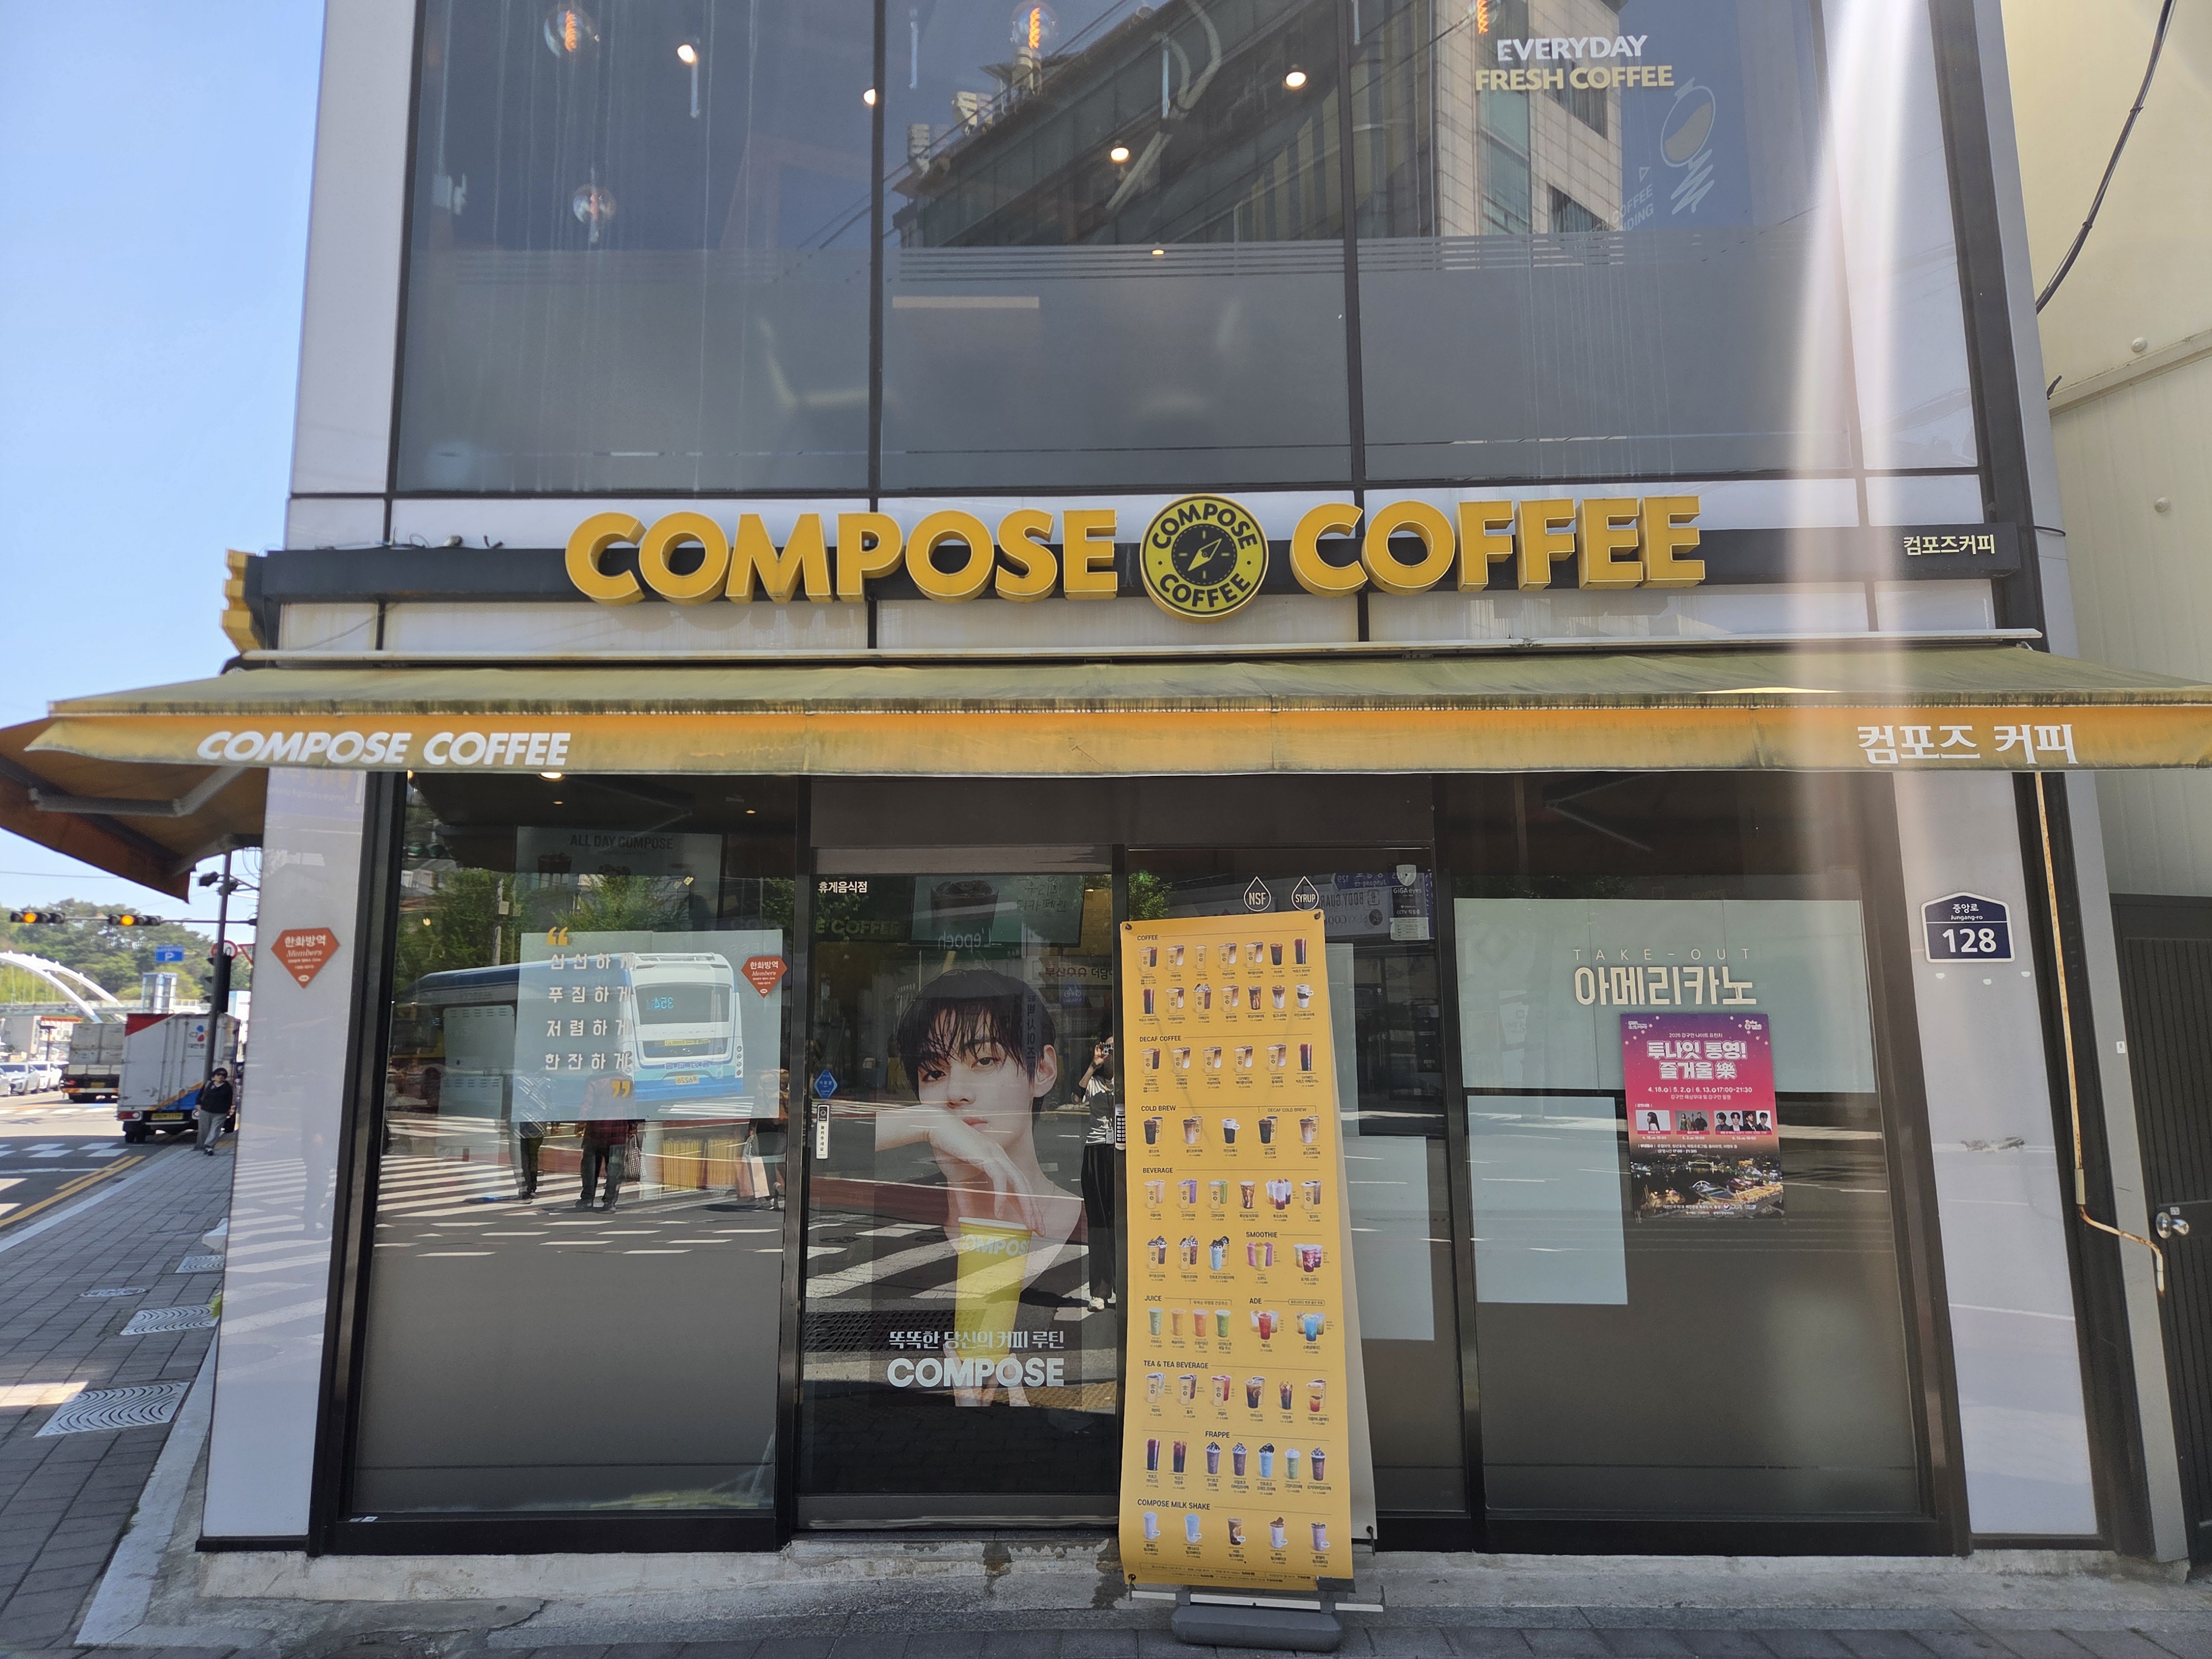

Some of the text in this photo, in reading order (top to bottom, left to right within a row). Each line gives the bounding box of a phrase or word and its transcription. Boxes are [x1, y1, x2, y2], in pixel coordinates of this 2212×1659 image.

[1498, 35, 1648, 61] EVERYDAY
[1475, 65, 1674, 91] FRESH COFFEE
[1152, 503, 1258, 550] COMPOSE
[1289, 496, 1705, 598] COFFEE
[1903, 534, 1995, 556] 컴포즈커피
[565, 509, 1118, 605] COMPOSE
[1160, 573, 1251, 608] COFFEE
[197, 731, 571, 765] COMPOSE COFFEE
[1857, 724, 2079, 764] 컴포즈 커피
[570, 834, 674, 849] ALL DAY COMPOSE
[818, 880, 868, 894] 휴게음식점
[1249, 893, 1266, 905] NSF
[1295, 893, 1316, 904] SYRUP
[1953, 904, 1979, 914] 중앙로
[1942, 928, 1997, 953] 128
[165, 952, 175, 961] P
[1573, 948, 1749, 961] TAKE-OUT
[750, 961, 779, 969] 한화방역
[548, 985, 632, 1004] 푸짐하게
[1574, 967, 1756, 1005] 아메리카노
[546, 1019, 633, 1037] 저렴하게
[1647, 1040, 1747, 1060] 투나잇 통영!
[1659, 1061, 1738, 1079] 즐거울 樂
[889, 1331, 1065, 1349] 똑똑한 당신의 커피 루틴
[887, 1358, 1065, 1387] COMPOSE
[1137, 1499, 1170, 1507] COMPOSE
[1188, 1502, 1211, 1510] SHAKE
